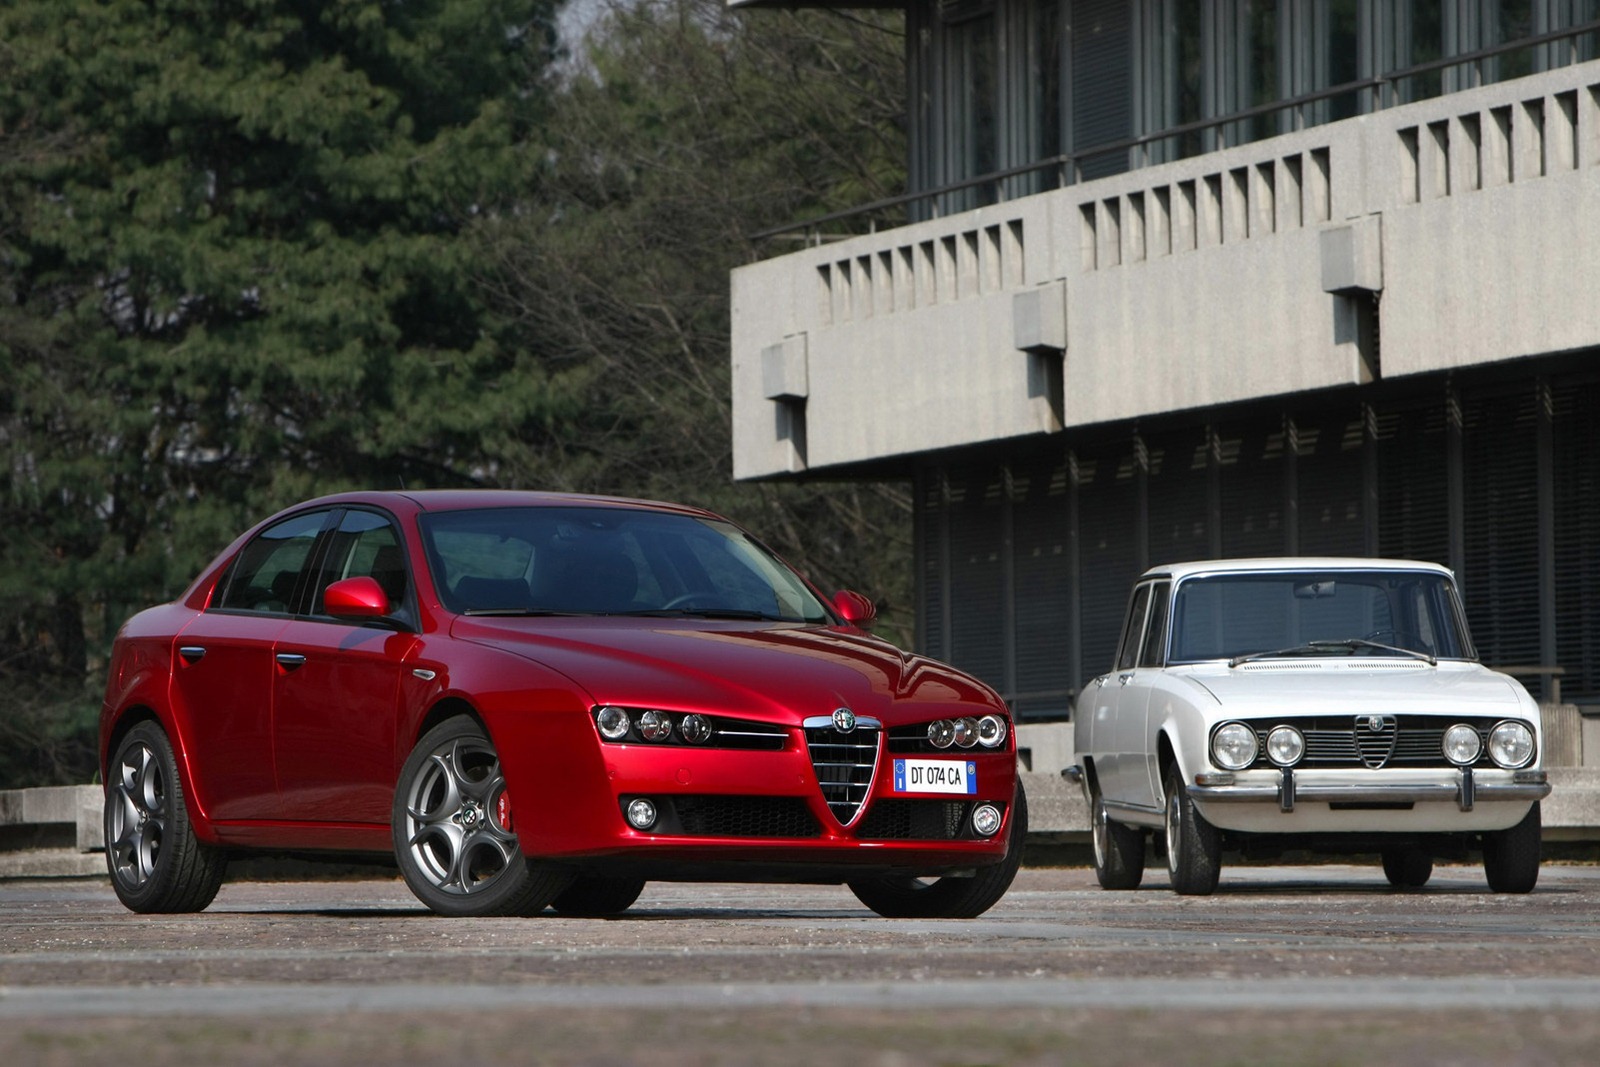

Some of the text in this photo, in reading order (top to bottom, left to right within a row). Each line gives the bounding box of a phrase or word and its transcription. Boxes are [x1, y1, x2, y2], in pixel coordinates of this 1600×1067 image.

[911, 766, 924, 785] DT
[927, 766, 946, 785] 074
[948, 767, 962, 785] CA
